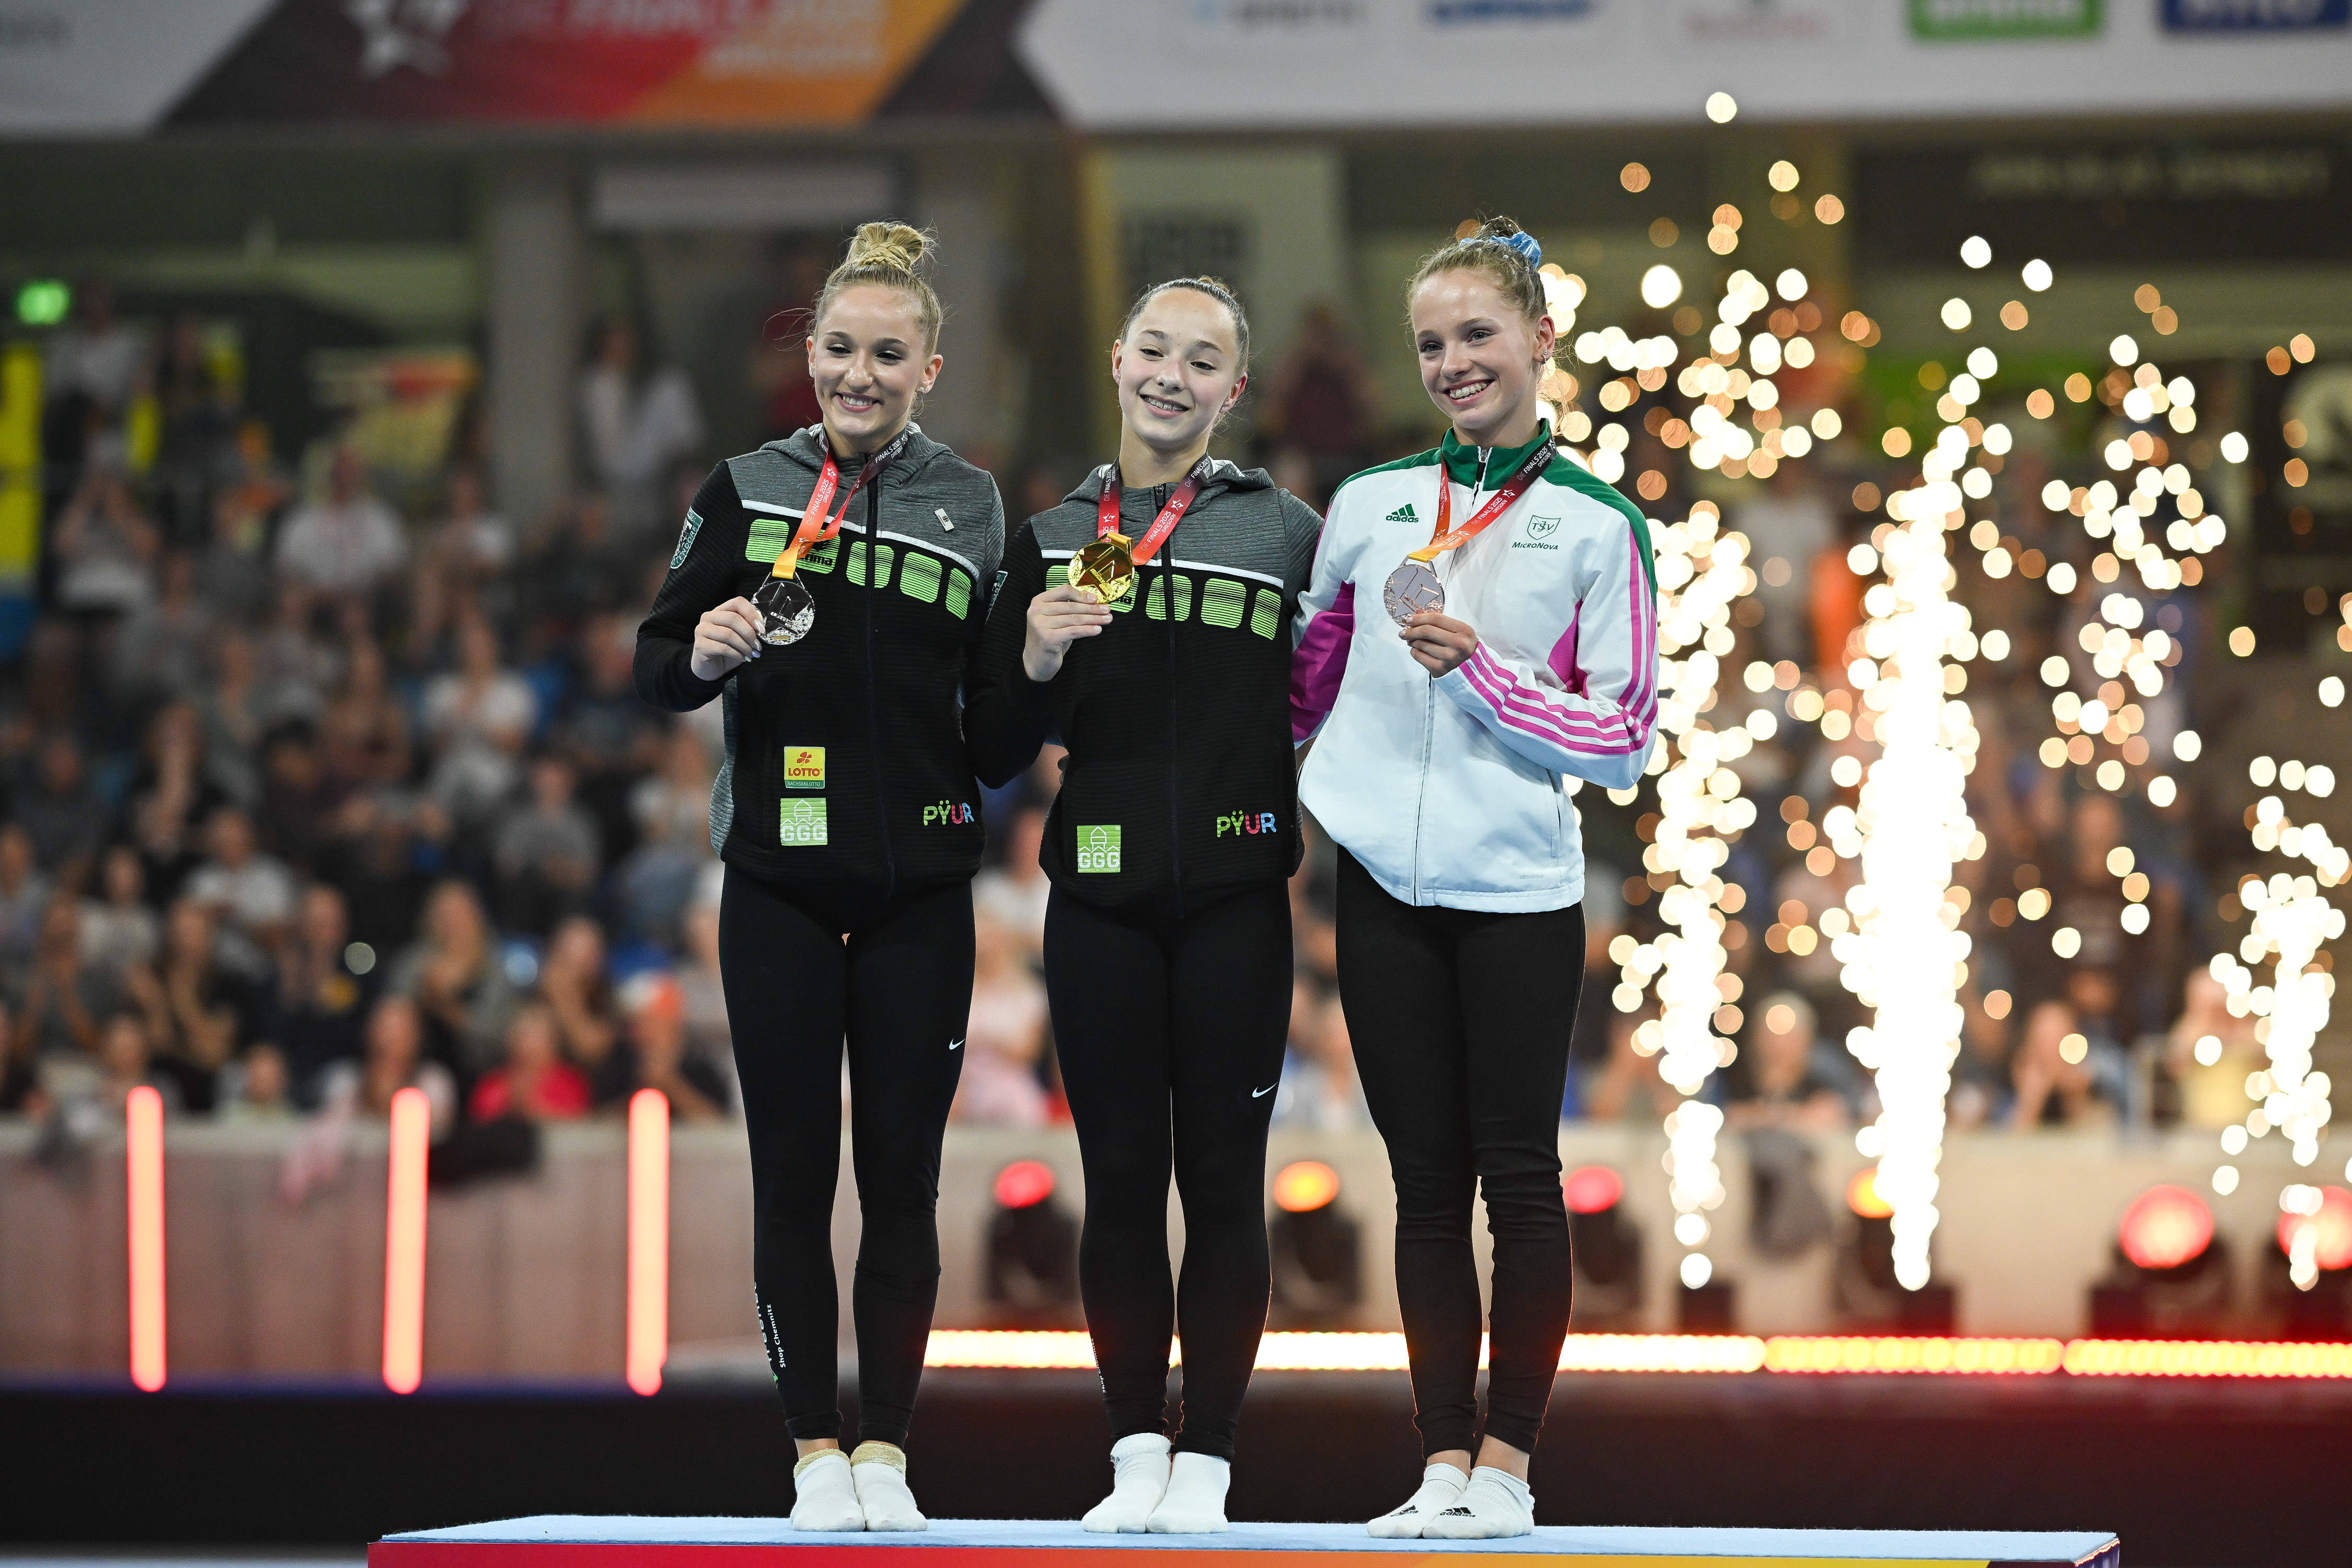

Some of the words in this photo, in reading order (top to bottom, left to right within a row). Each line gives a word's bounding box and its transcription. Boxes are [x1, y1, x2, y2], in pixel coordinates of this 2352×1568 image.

[875, 446, 893, 464] FINALS
[892, 439, 901, 449] 2025
[1537, 451, 1551, 467] DRESDEN
[1517, 471, 1526, 481] DIE
[1523, 456, 1539, 474] FINALS
[1537, 446, 1548, 459] 2025
[1184, 477, 1194, 487] DIE
[1191, 464, 1203, 479] FINALS
[806, 516, 815, 526] DIE
[811, 493, 823, 515] FINALS
[819, 478, 829, 495] 2025
[823, 482, 834, 503] DRESDEN
[1477, 506, 1494, 520] FINALS
[1491, 497, 1503, 508] 2025
[1492, 499, 1508, 513] DRESDEN
[1161, 513, 1177, 533] DRESDEN
[1386, 514, 1419, 523] adidas
[1140, 541, 1150, 551] DIE
[1147, 524, 1163, 543] FINALS
[1160, 510, 1172, 525] 2025
[788, 767, 821, 777] LOTTO
[924, 800, 974, 826] PŸUR
[1217, 810, 1277, 837] PŸUR
[781, 825, 826, 841] GGG
[1078, 851, 1120, 868] GGG
[767, 1304, 780, 1345] Chemnitz
